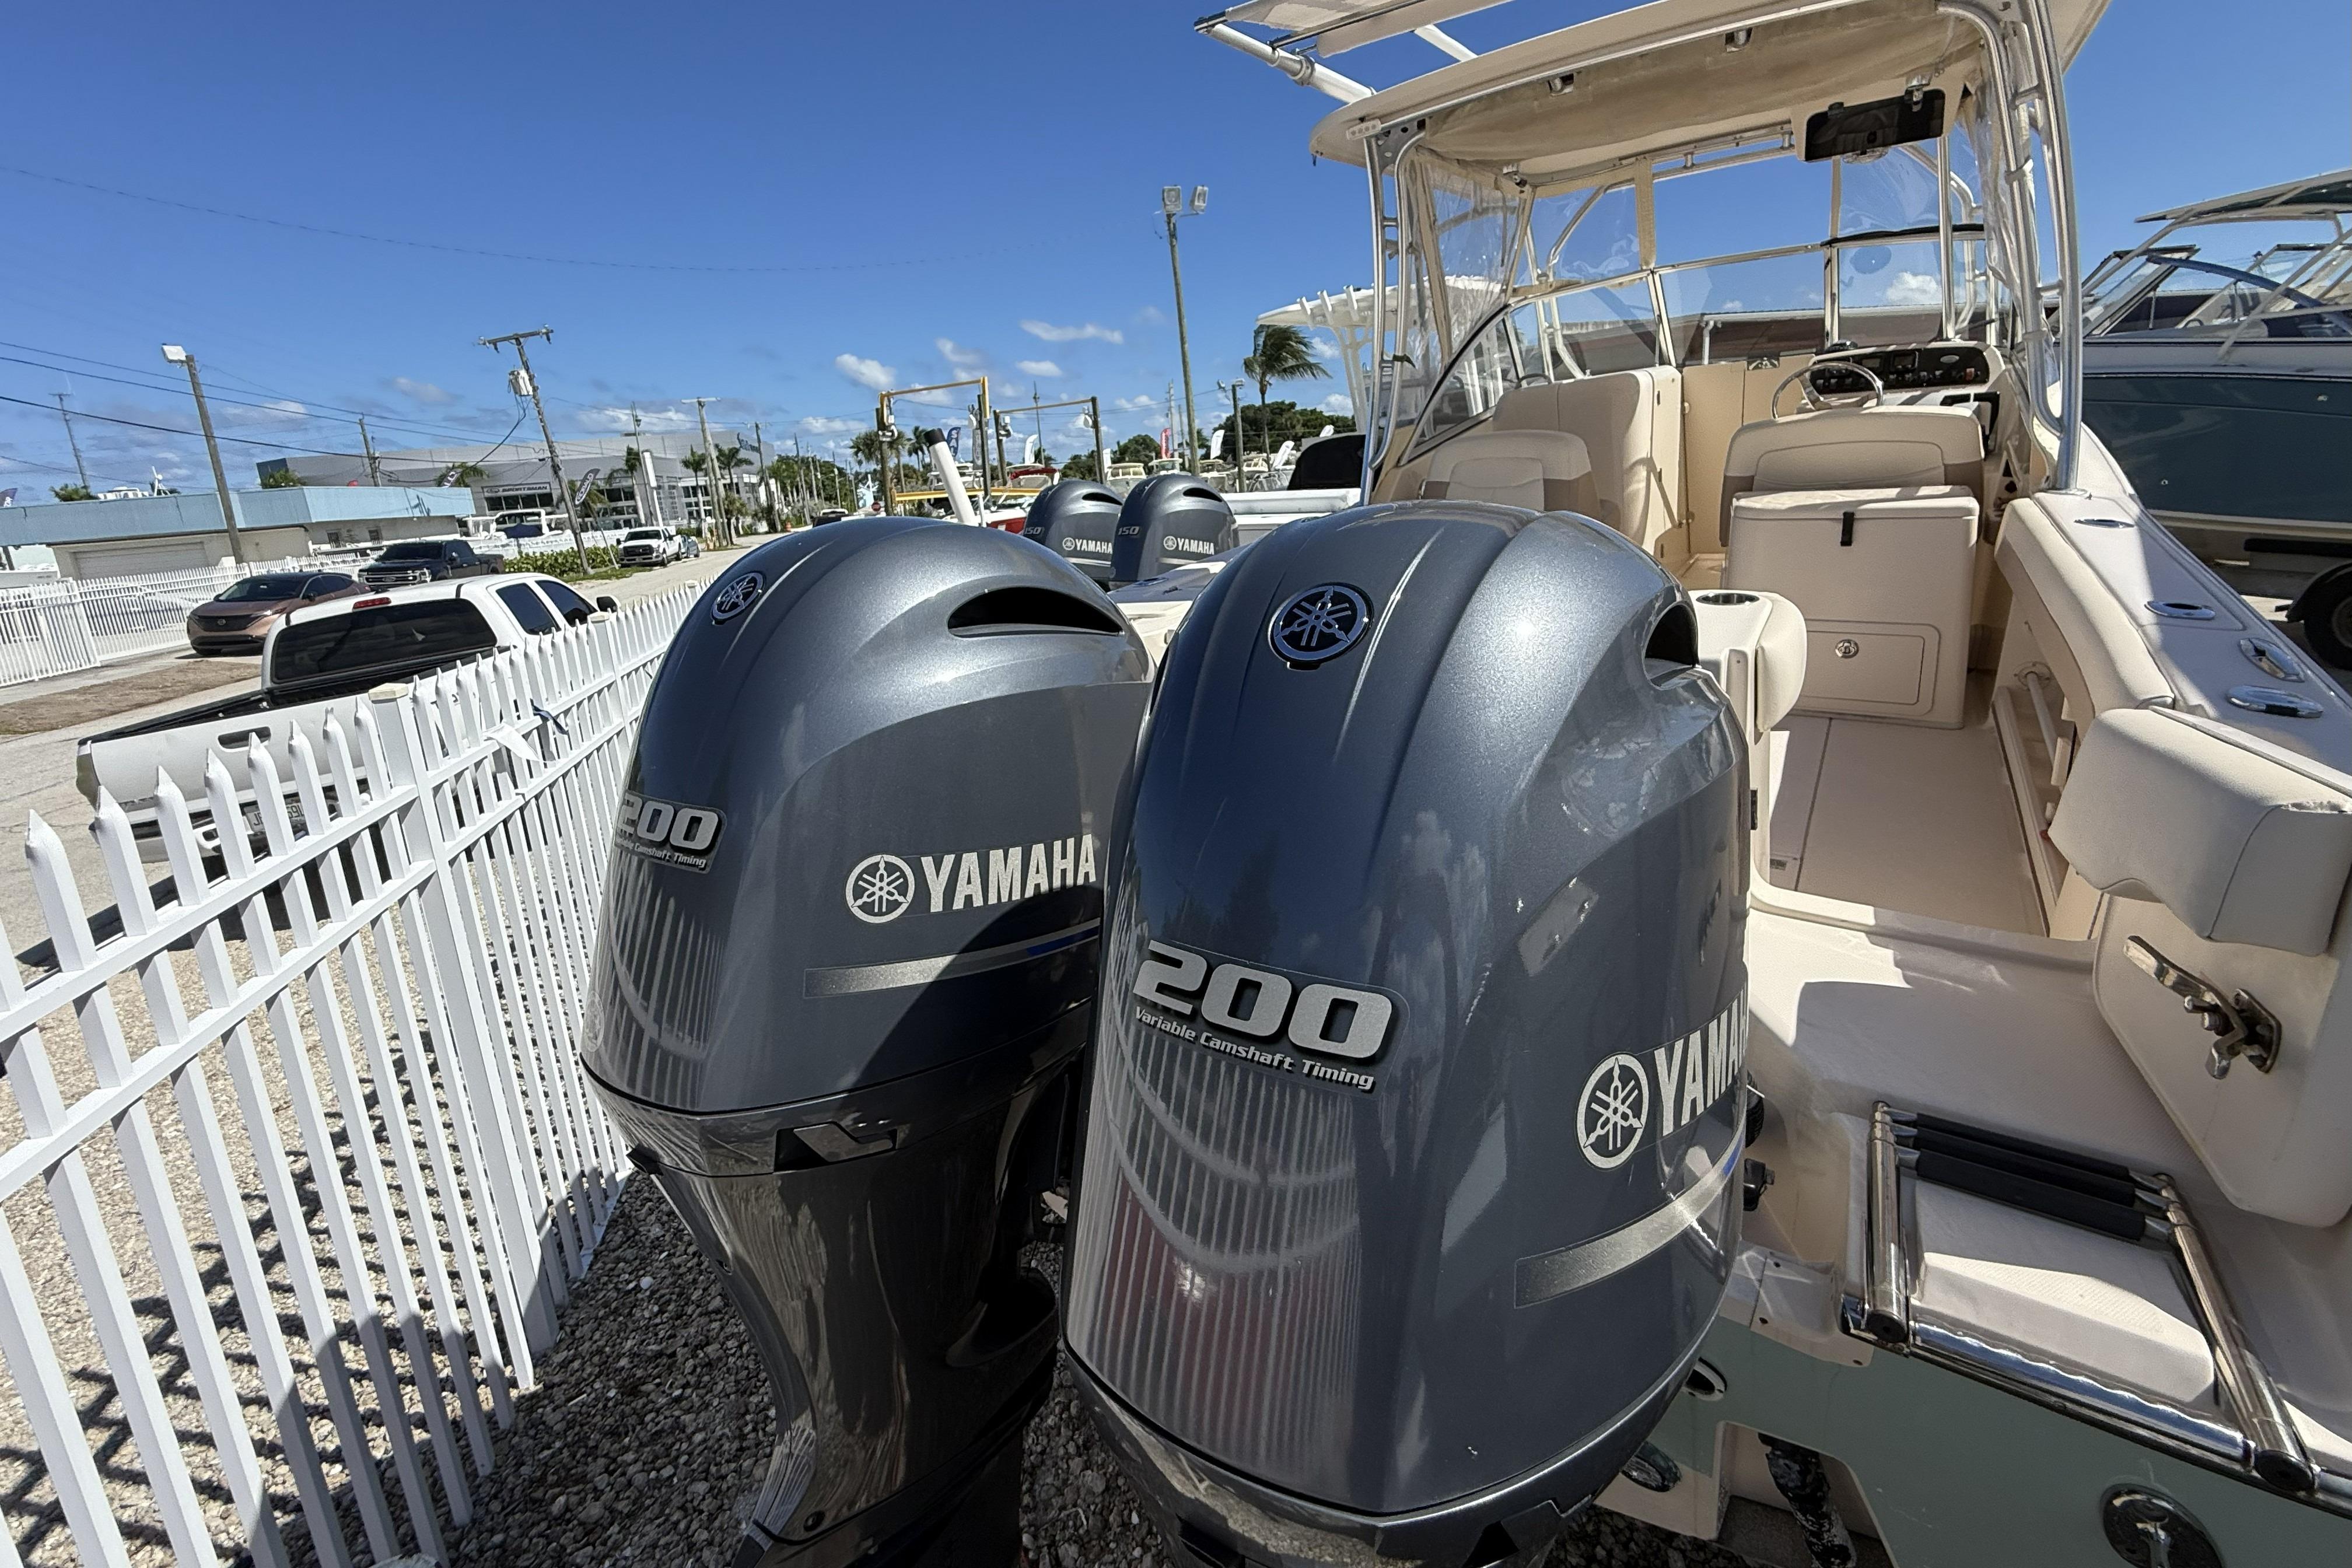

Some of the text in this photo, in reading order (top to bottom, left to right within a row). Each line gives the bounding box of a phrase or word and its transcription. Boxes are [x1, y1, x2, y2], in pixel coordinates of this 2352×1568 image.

[949, 429, 959, 456] SAL
[1024, 527, 1041, 535] 150
[1118, 526, 1139, 536] 150
[1075, 538, 1112, 554] YAMAHA
[1177, 538, 1214, 555] YAMAHA
[617, 792, 719, 850] 200
[673, 852, 706, 868] Timing
[921, 834, 1096, 913] YAMAHA
[1133, 940, 1392, 1059] 200
[1135, 1006, 1375, 1091] Variable Camshaft Timing
[1653, 988, 1746, 1137] YAMAH
